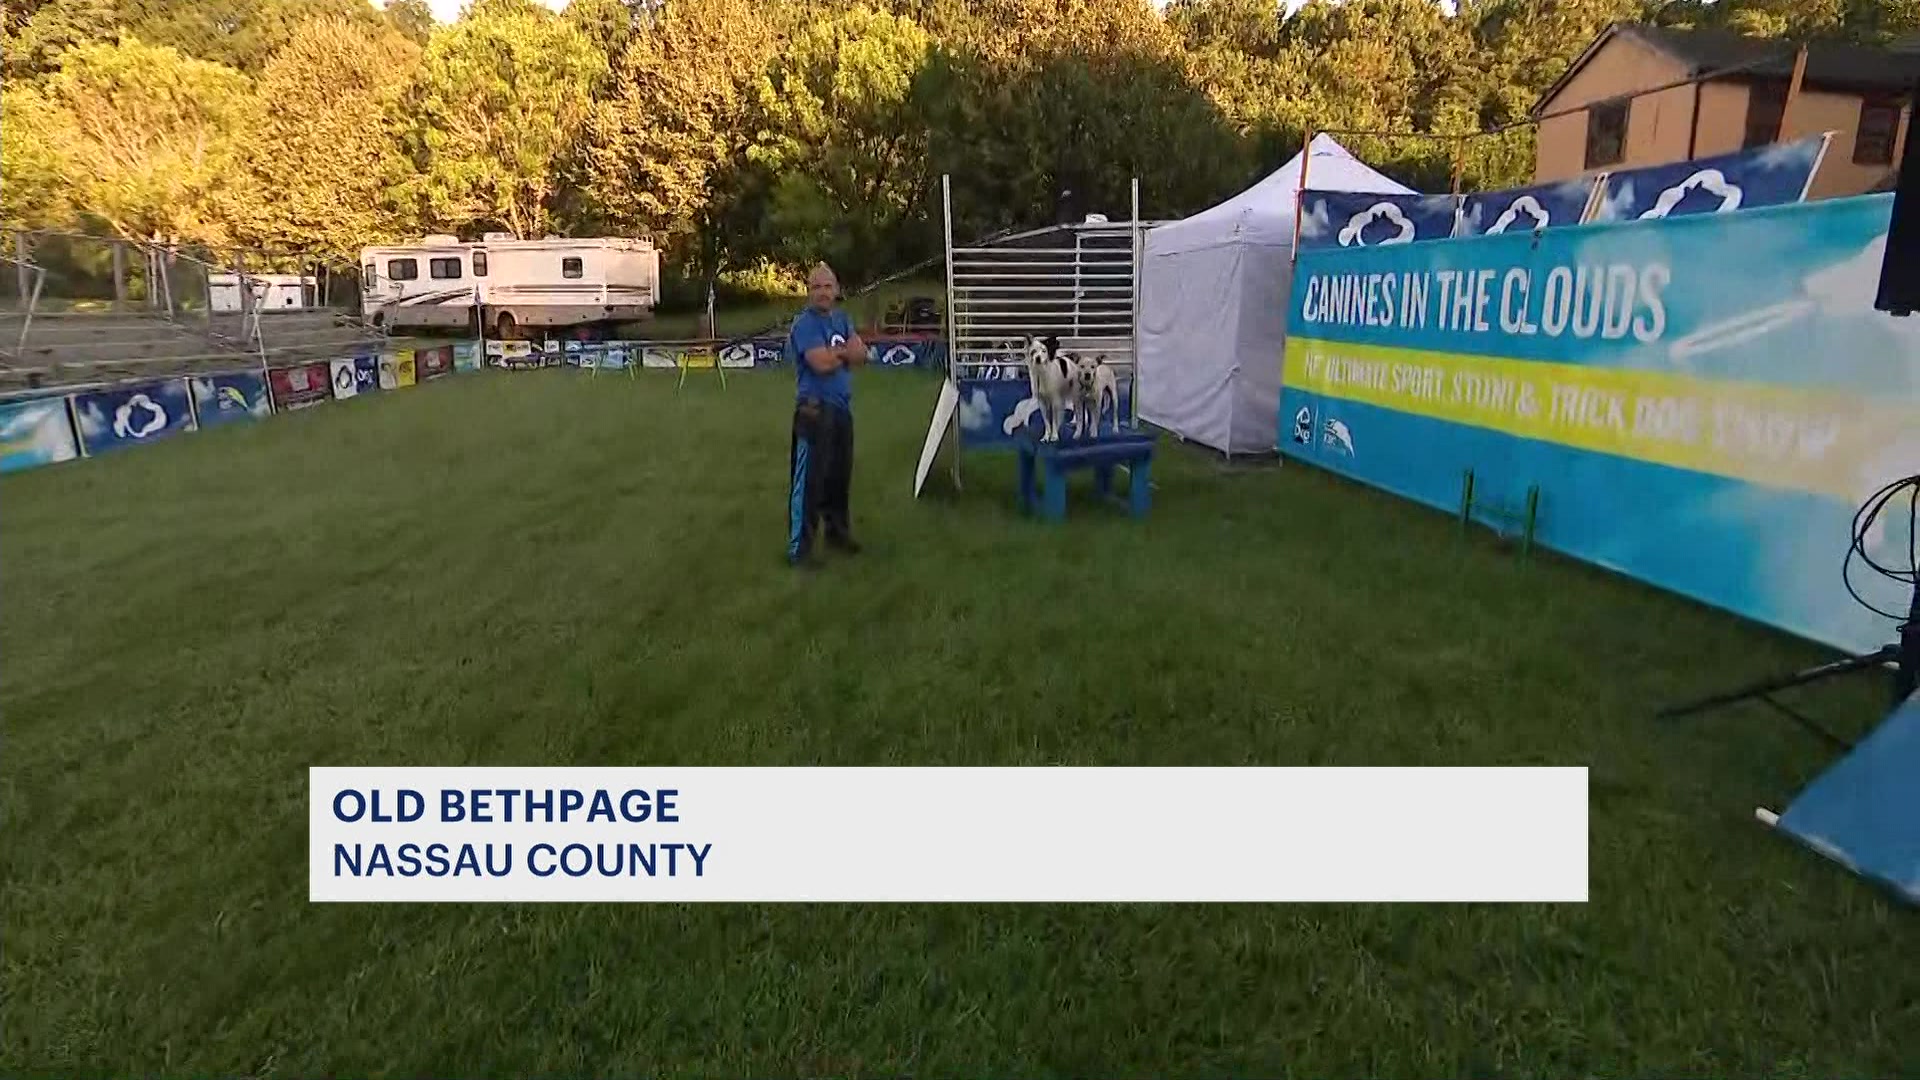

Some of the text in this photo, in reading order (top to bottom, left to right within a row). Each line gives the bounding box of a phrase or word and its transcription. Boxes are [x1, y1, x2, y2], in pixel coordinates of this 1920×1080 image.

[1302, 264, 1670, 342] CANINES IN THE CLOUDS
[1515, 379, 1541, 417] &
[1550, 383, 1625, 430] TRICK
